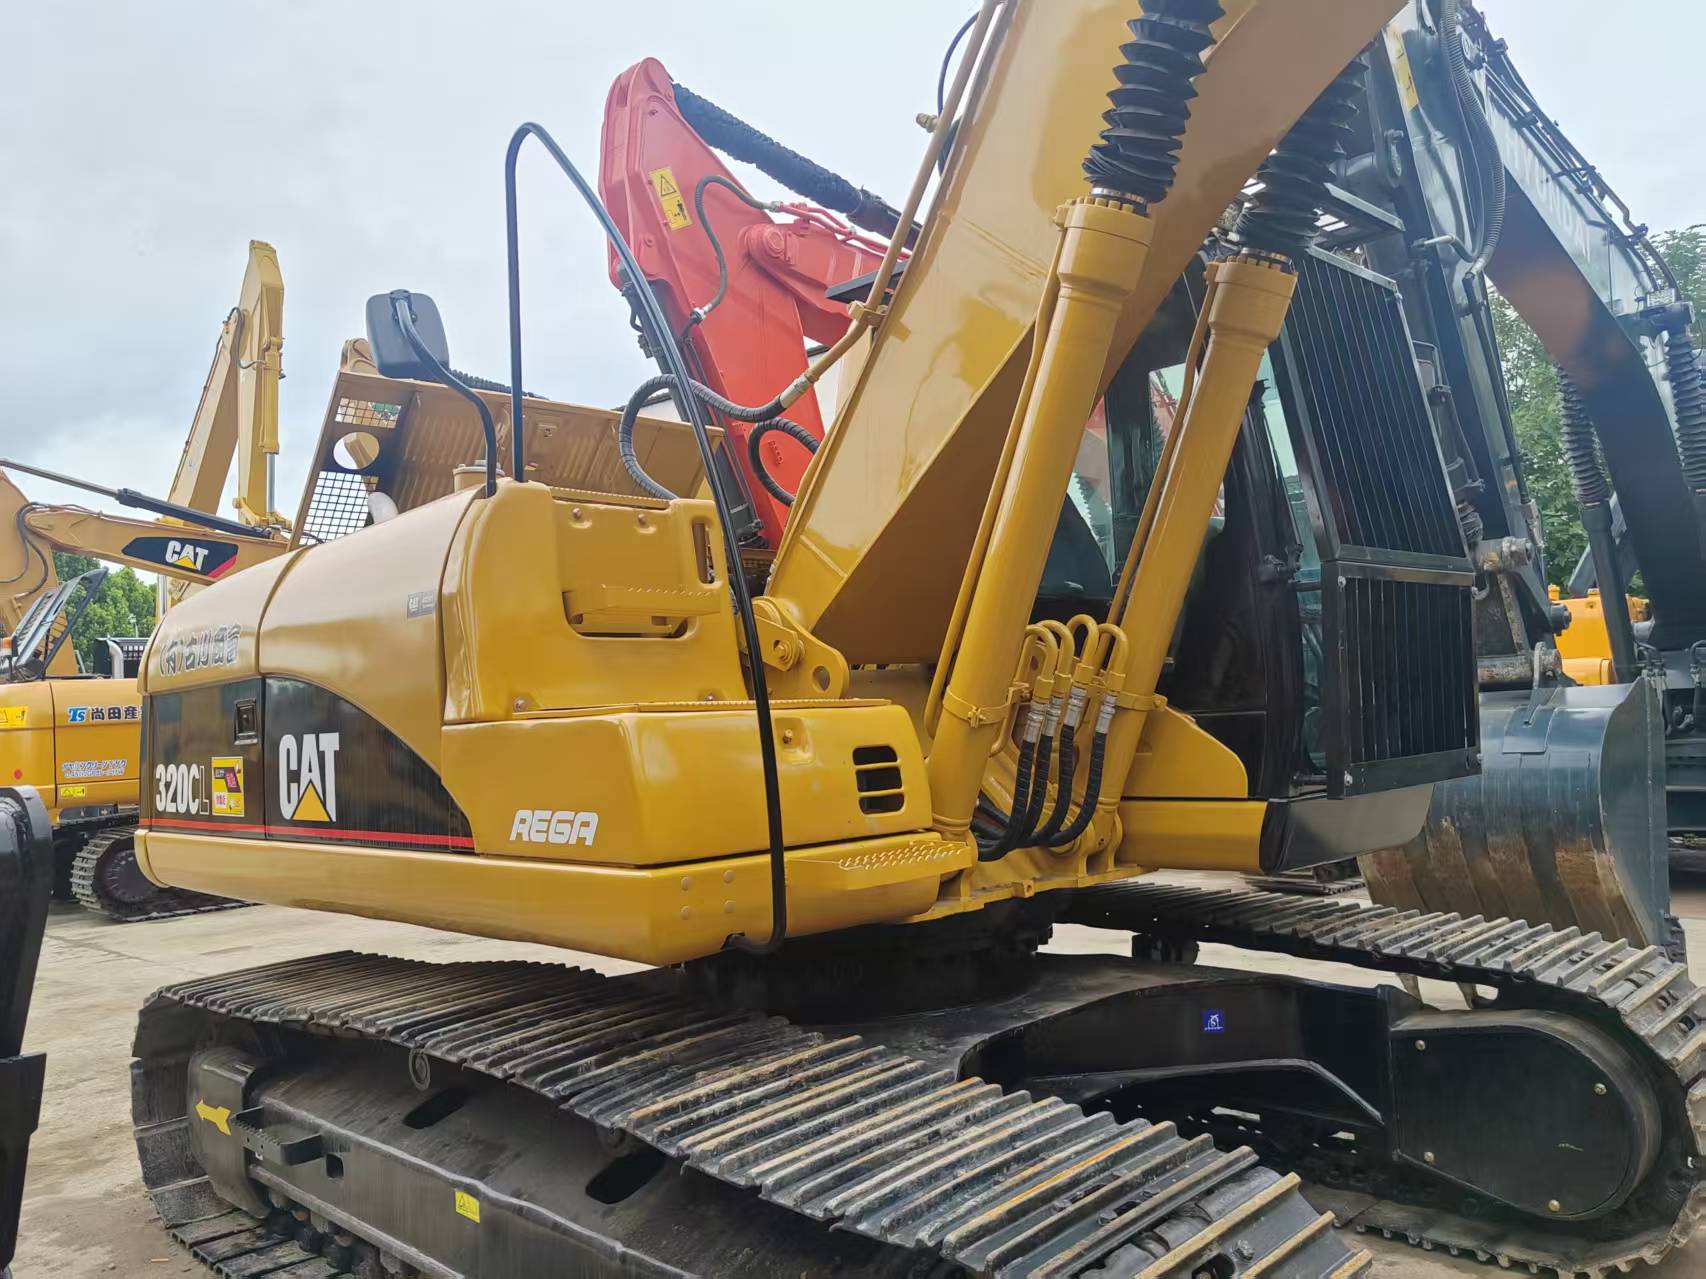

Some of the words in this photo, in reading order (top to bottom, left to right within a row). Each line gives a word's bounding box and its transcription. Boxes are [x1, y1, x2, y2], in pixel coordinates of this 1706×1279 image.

[1504, 116, 1592, 263] HYUNDAI
[165, 540, 209, 571] CAT
[91, 706, 142, 721] 尚田産
[279, 732, 340, 822] CAT
[509, 809, 599, 846] REGA
